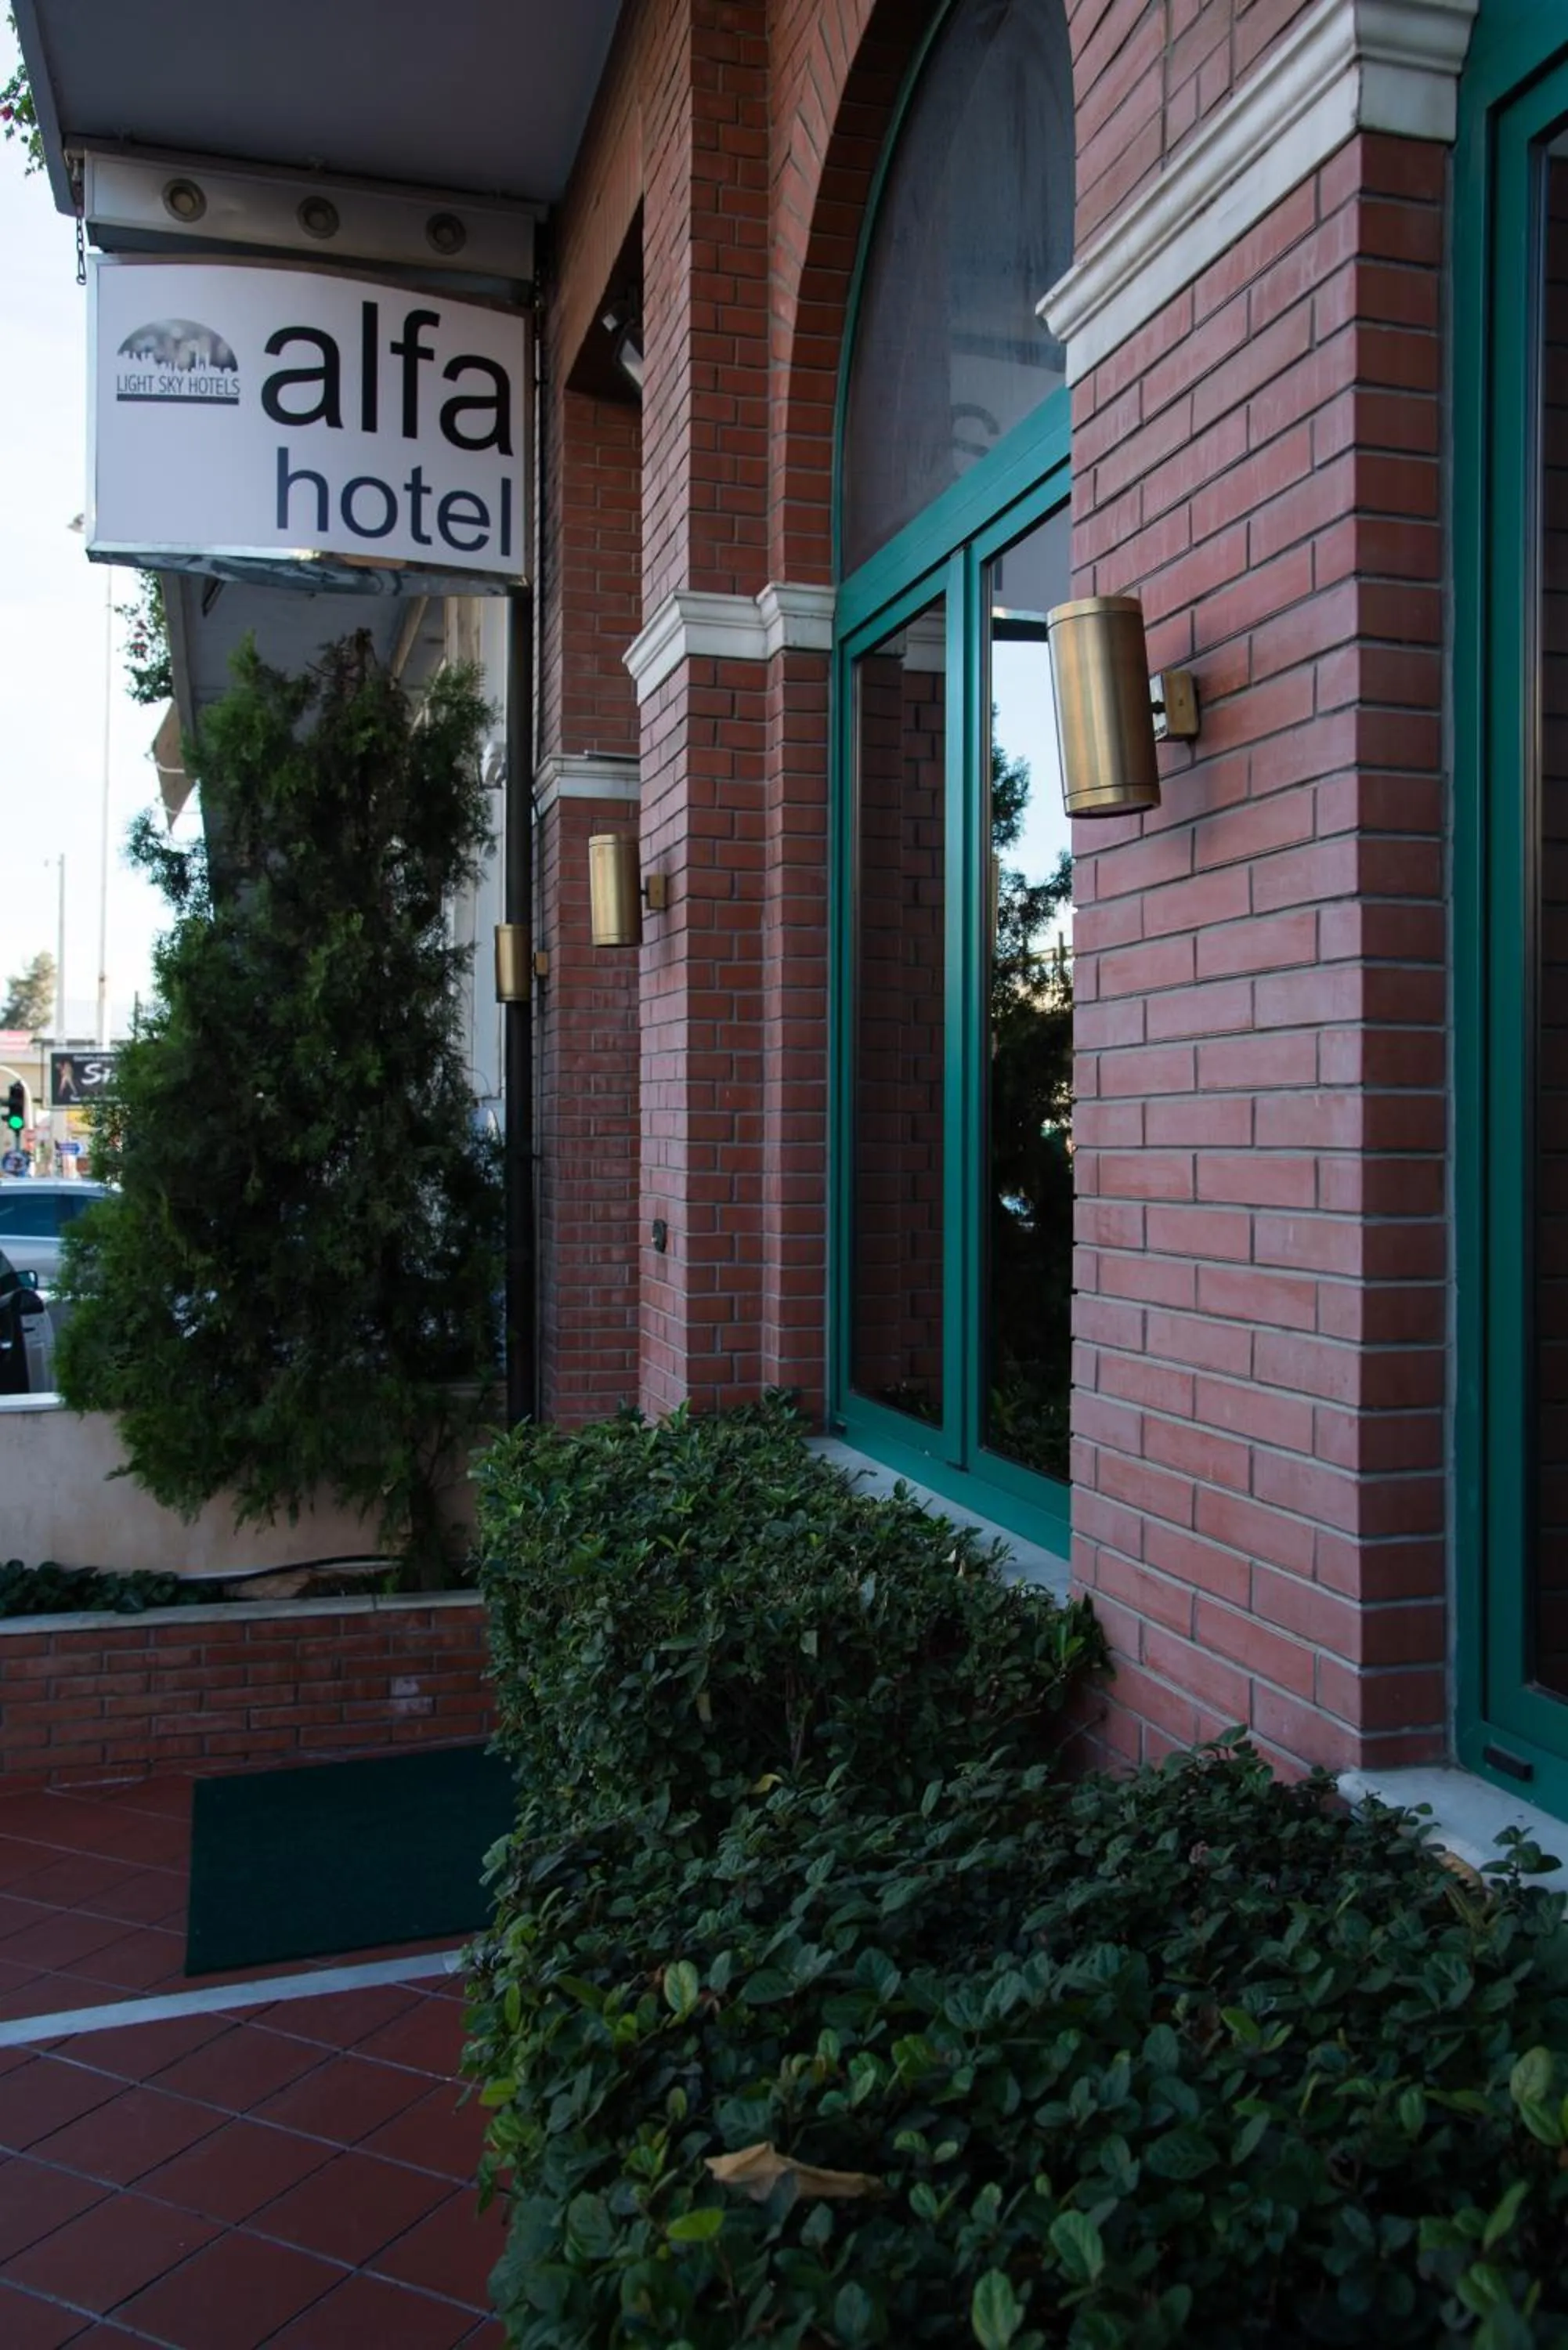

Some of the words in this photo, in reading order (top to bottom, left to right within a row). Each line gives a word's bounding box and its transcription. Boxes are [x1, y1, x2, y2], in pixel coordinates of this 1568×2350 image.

[117, 374, 154, 392] LIGHT
[158, 375, 184, 393] SKY
[188, 377, 240, 396] HOTELS
[261, 301, 514, 457] alfa
[276, 446, 512, 557] hotel
